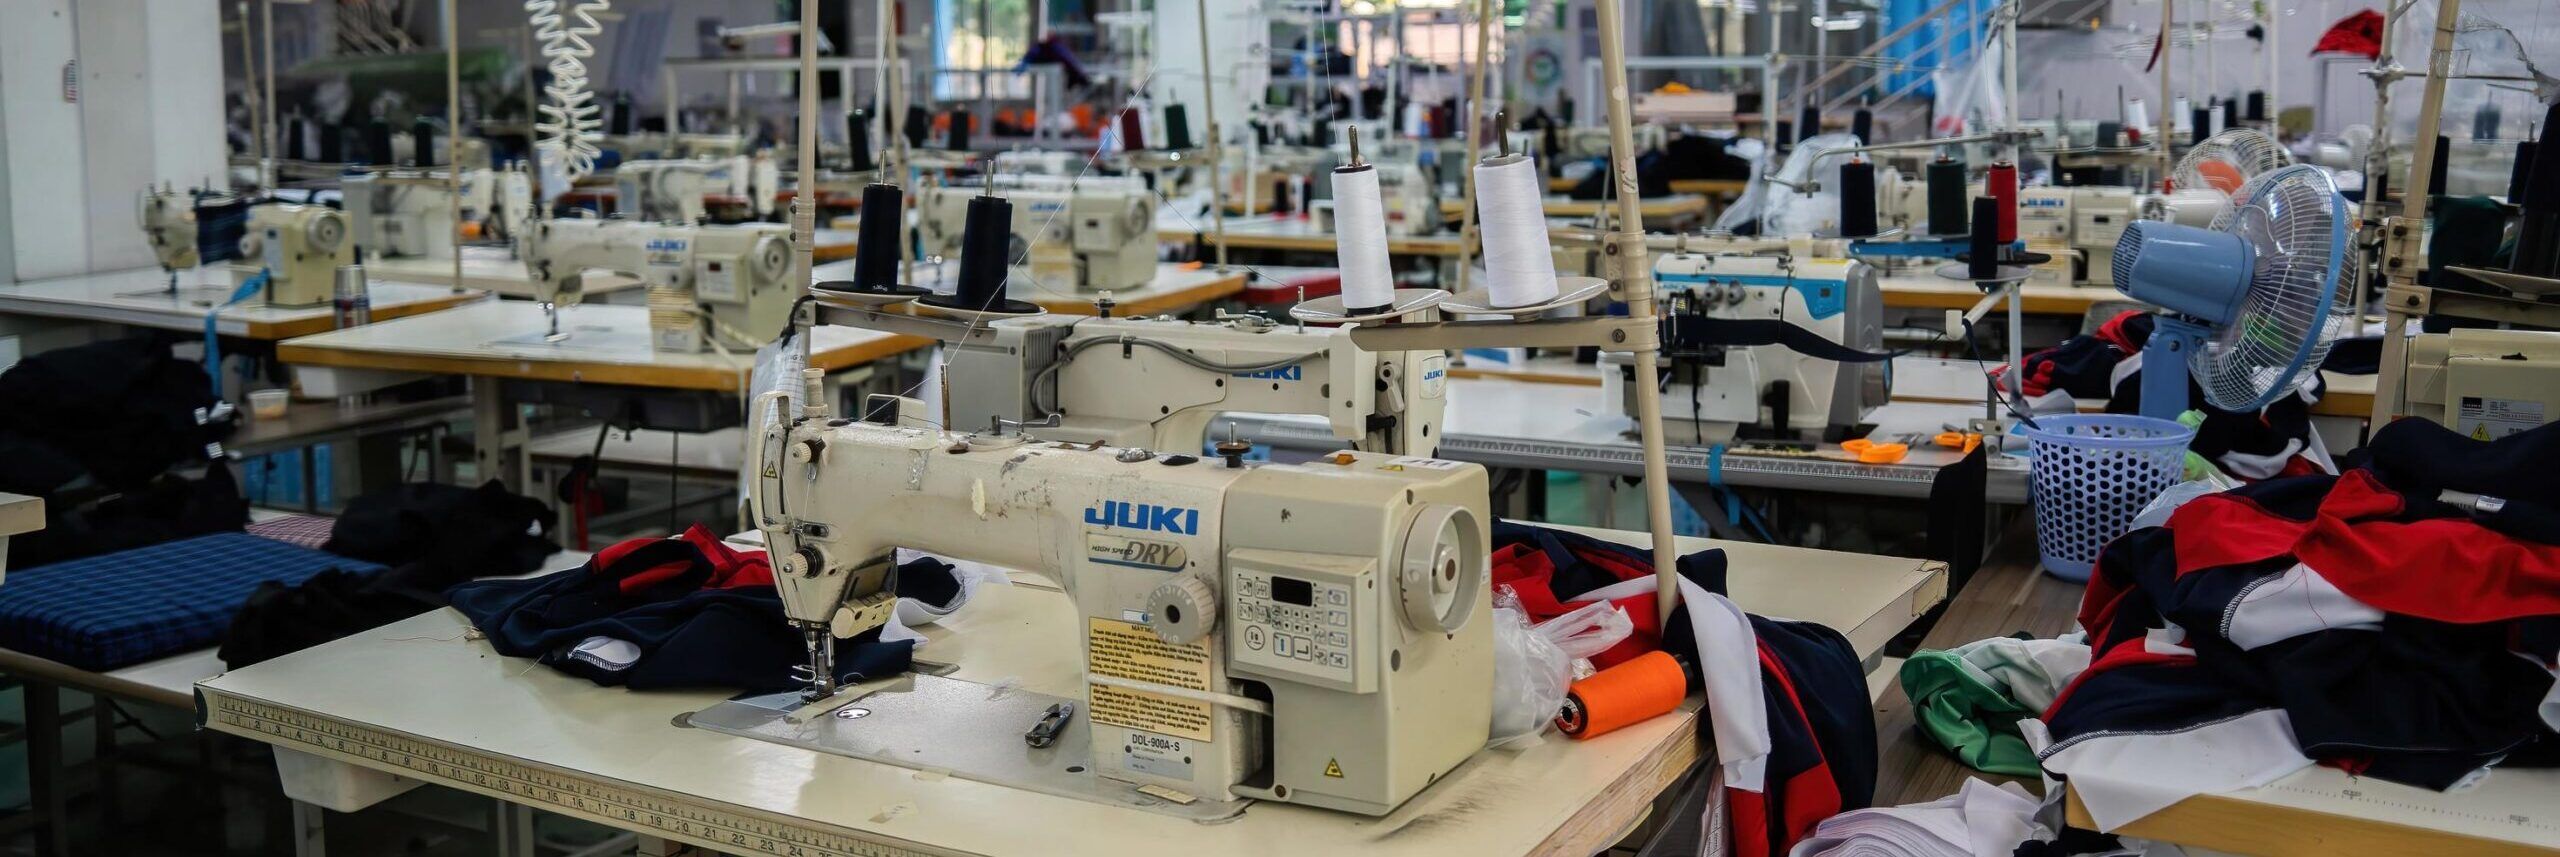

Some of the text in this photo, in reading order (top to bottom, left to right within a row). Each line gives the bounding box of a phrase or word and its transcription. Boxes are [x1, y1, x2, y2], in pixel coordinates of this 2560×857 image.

[1424, 369, 1443, 380] JUKI
[1085, 500, 1198, 535] JUKI
[1092, 541, 1179, 566] HIGH SPEED DRY
[451, 768, 460, 778] 11
[474, 773, 485, 784] 12
[498, 779, 509, 790] 13
[522, 785, 533, 796] 14
[547, 791, 558, 802] 15
[572, 796, 583, 808] 16
[597, 802, 608, 814] 17
[623, 809, 634, 820] 18
[650, 815, 661, 826] 19
[704, 826, 715, 838] 21
[731, 833, 745, 845] 22
[760, 839, 773, 851] 23
[789, 845, 802, 857] 24
